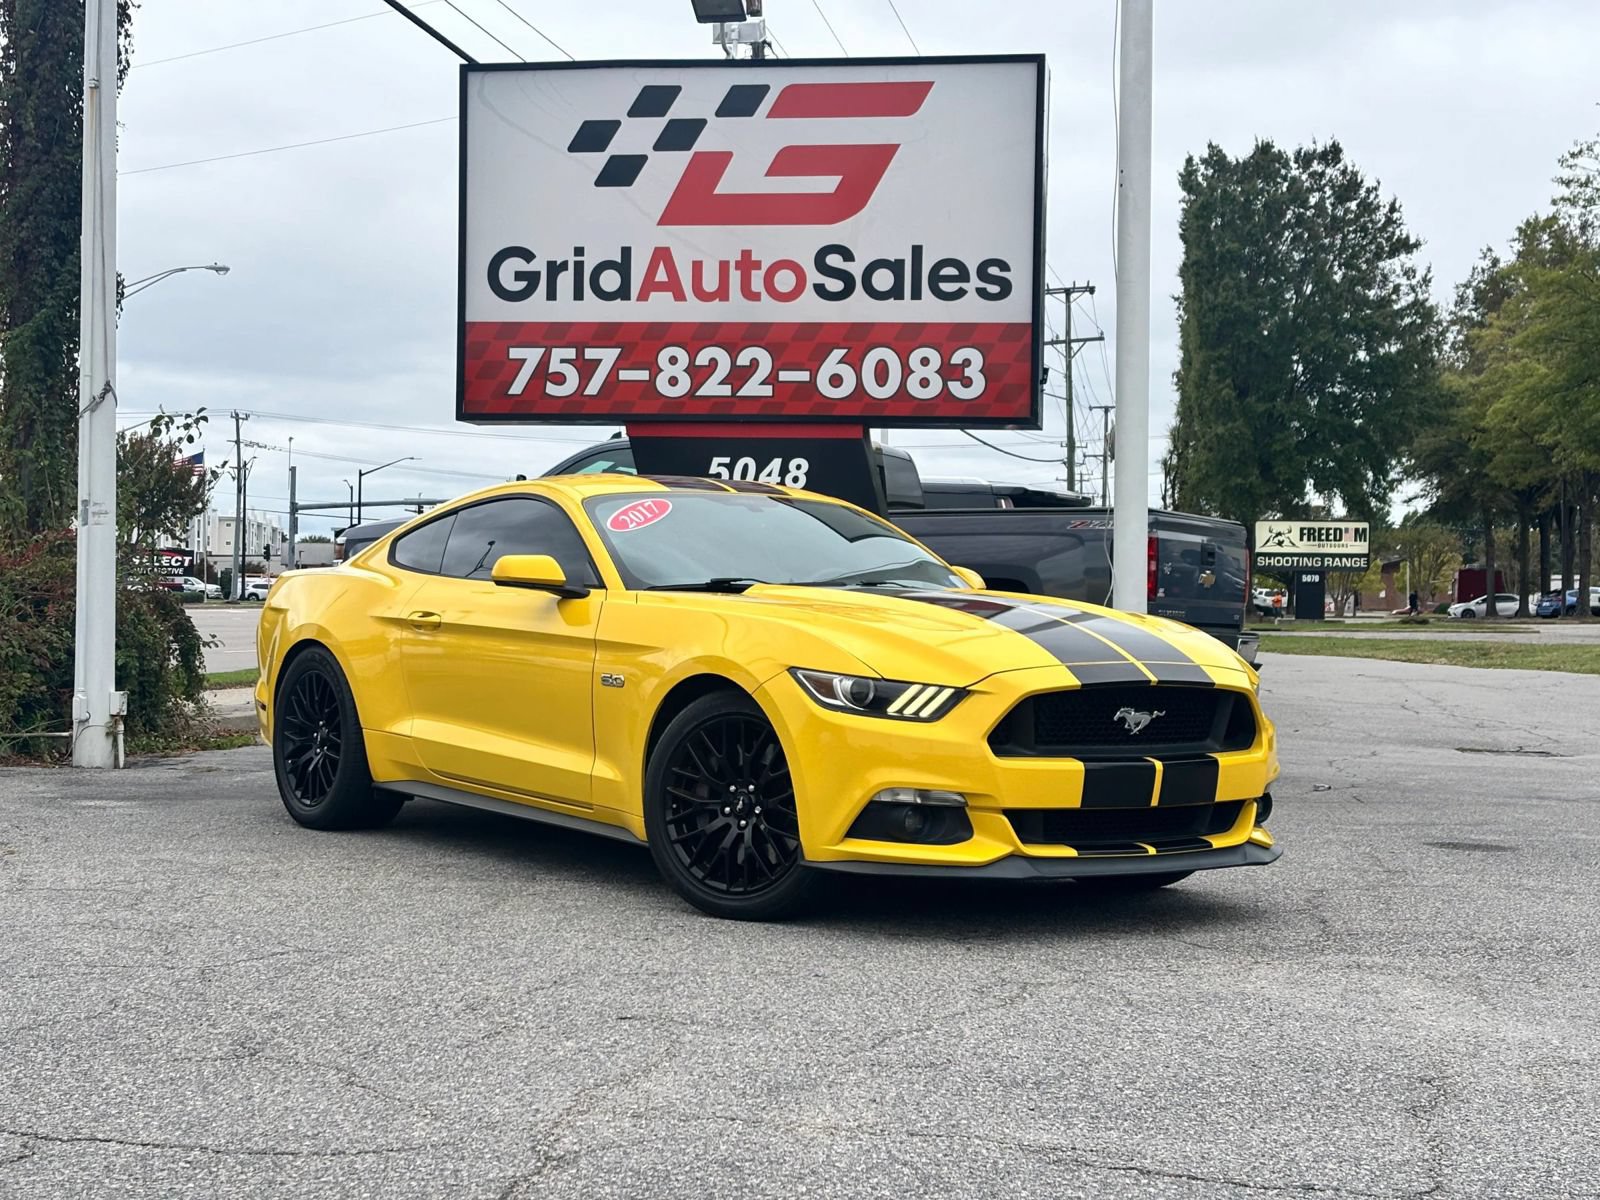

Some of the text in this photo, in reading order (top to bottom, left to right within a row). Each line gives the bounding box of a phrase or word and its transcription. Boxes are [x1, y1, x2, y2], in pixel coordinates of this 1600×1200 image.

[506, 345, 987, 400] 757-822-6083
[708, 456, 809, 489] 5048
[618, 500, 660, 529] 2017
[1299, 526, 1368, 543] FREEDM
[1257, 556, 1368, 568] SHOOTING RANGE
